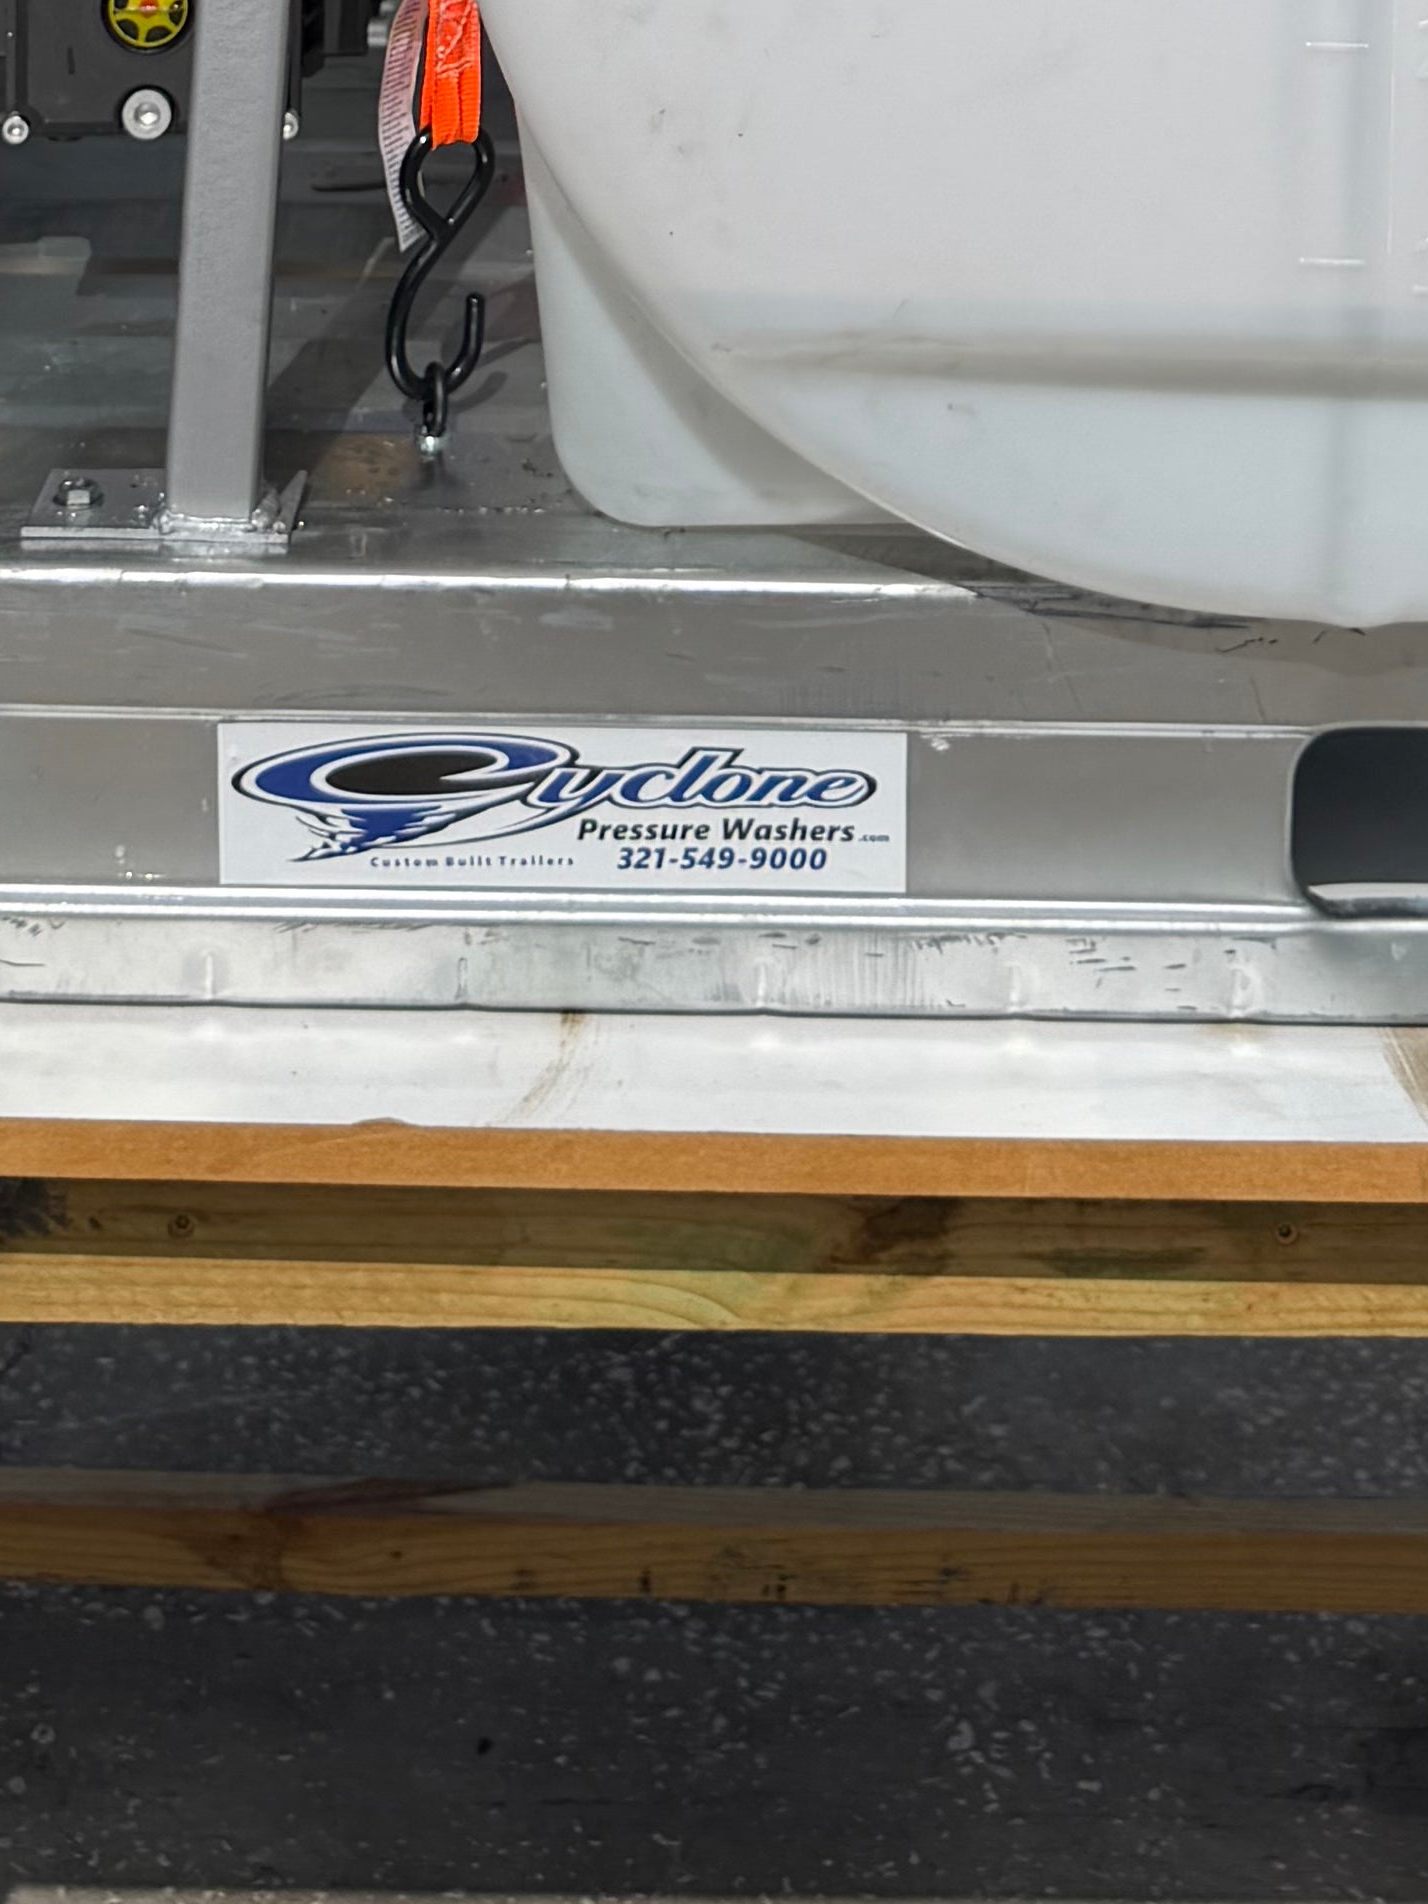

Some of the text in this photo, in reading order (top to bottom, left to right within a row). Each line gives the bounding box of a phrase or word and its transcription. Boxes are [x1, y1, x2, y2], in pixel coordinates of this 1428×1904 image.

[231, 732, 877, 856] Cyclone
[577, 817, 711, 841] Pressure
[721, 817, 855, 842] Washers
[370, 854, 574, 867] Custom Built Trailers
[617, 846, 828, 871] 321-549-9000
